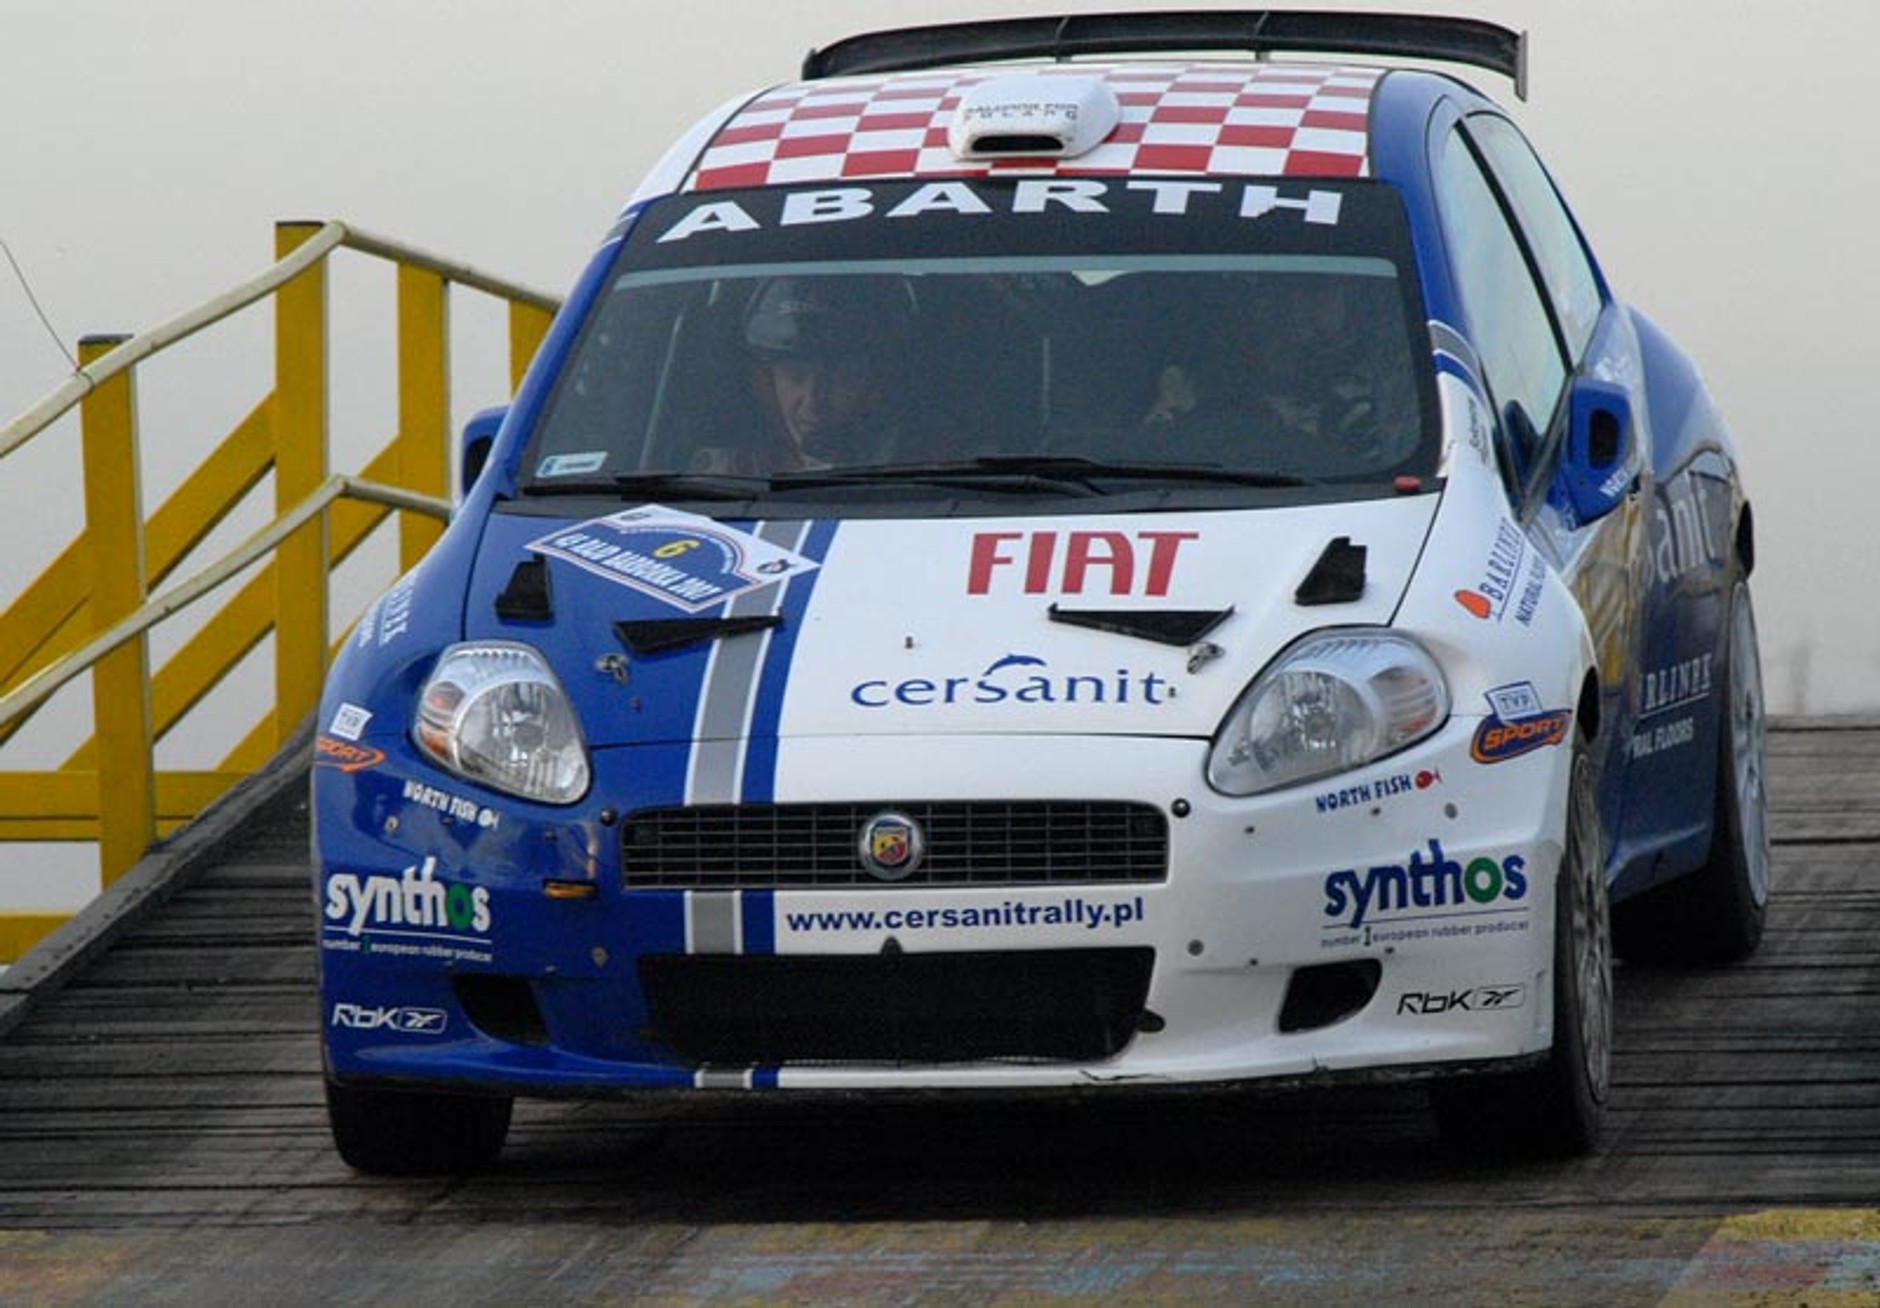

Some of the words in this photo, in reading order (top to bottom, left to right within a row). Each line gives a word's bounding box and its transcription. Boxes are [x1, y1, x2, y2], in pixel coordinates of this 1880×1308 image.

[656, 179, 1343, 244] ABARTH
[652, 539, 702, 559] 6
[966, 531, 1200, 597] FIAT
[850, 668, 1167, 707] cersanit
[1484, 714, 1563, 751] SPORT
[403, 781, 450, 812] NORTH
[449, 796, 479, 823] FISH
[1316, 785, 1371, 813] NORTH
[1375, 775, 1412, 799] FISH
[325, 856, 491, 936] synthos
[1324, 838, 1528, 929] synthos
[786, 897, 1144, 932] www.cersanitrally.pl
[1431, 923, 1472, 938] rubber
[1475, 920, 1530, 935] producer
[1397, 988, 1473, 1016] RbK
